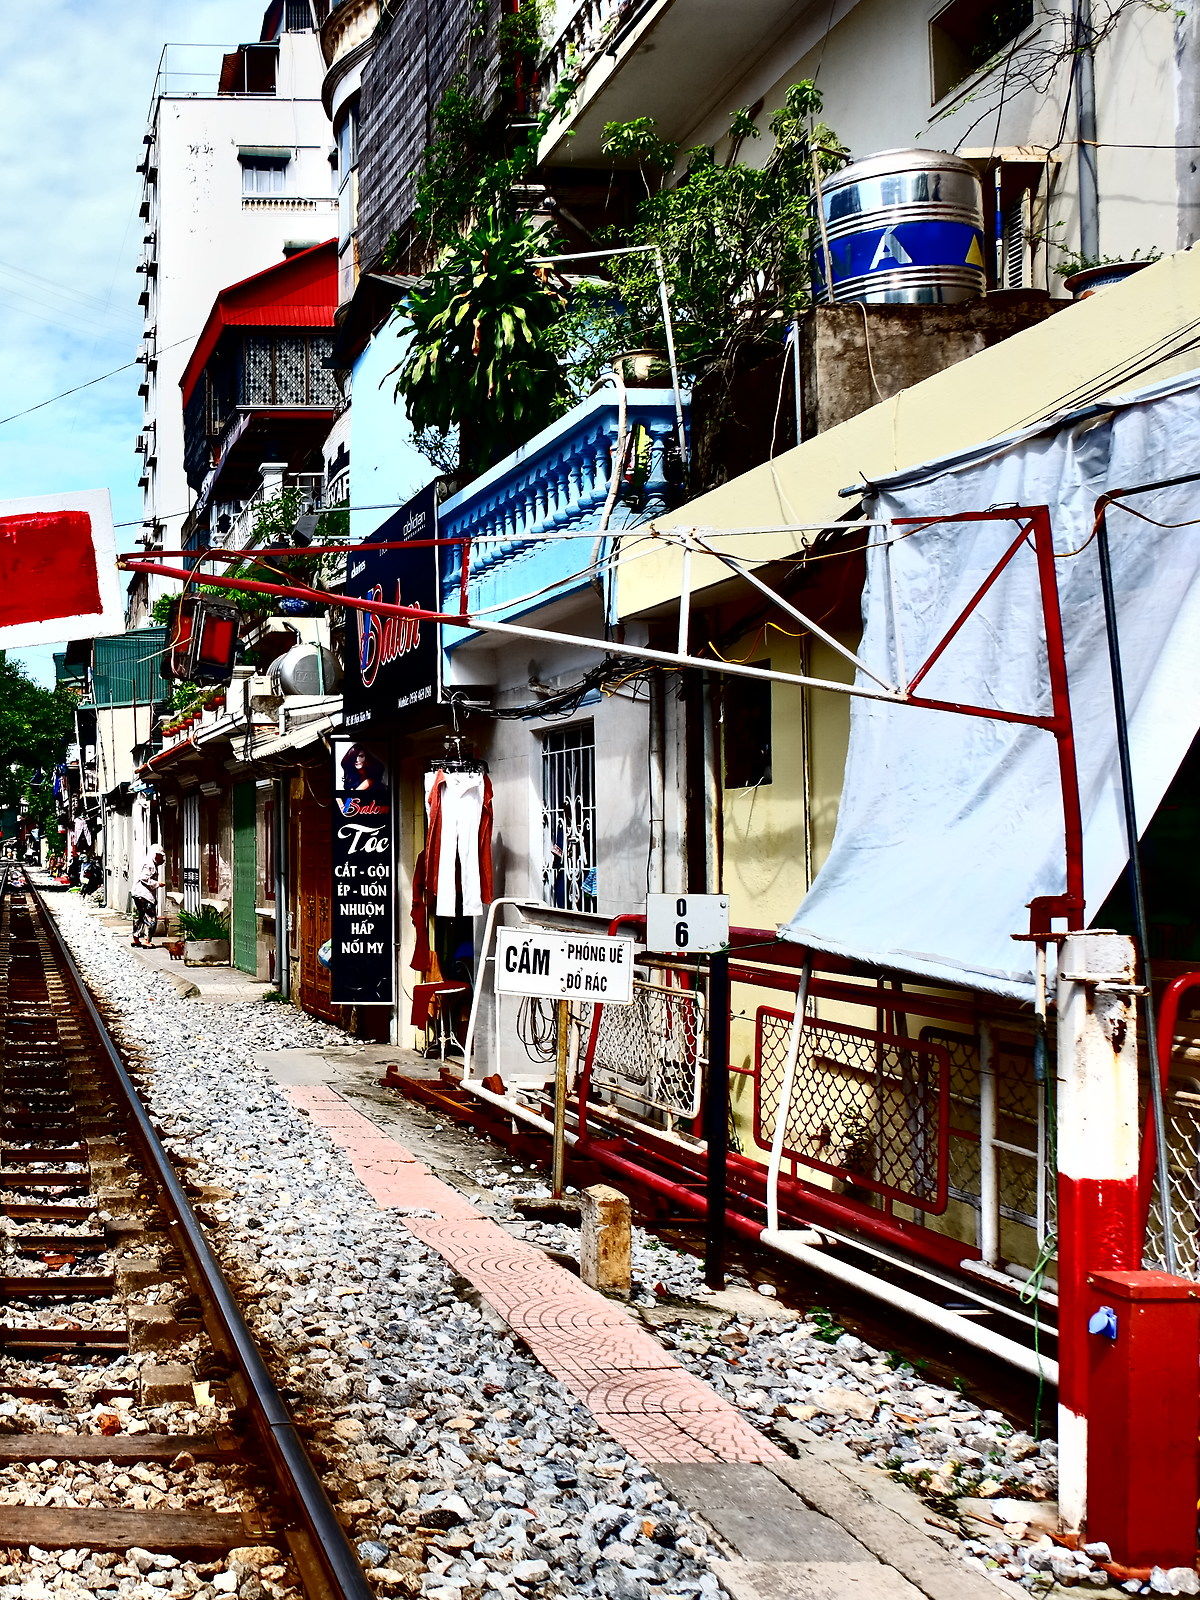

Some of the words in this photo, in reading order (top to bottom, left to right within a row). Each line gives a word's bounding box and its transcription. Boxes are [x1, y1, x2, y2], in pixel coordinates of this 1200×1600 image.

[337, 823, 389, 854] Tóc
[367, 862, 390, 880] GỘI
[337, 881, 351, 897] ÉP
[360, 880, 387, 897] UỐN
[339, 901, 385, 918] NHUỘM
[351, 919, 375, 935] HẤP
[675, 921, 689, 948] 6
[341, 938, 364, 954] NỐI
[366, 942, 385, 954] MY
[609, 943, 625, 964] UẾ
[505, 938, 551, 976] CẤM
[584, 971, 608, 992] RÁC
